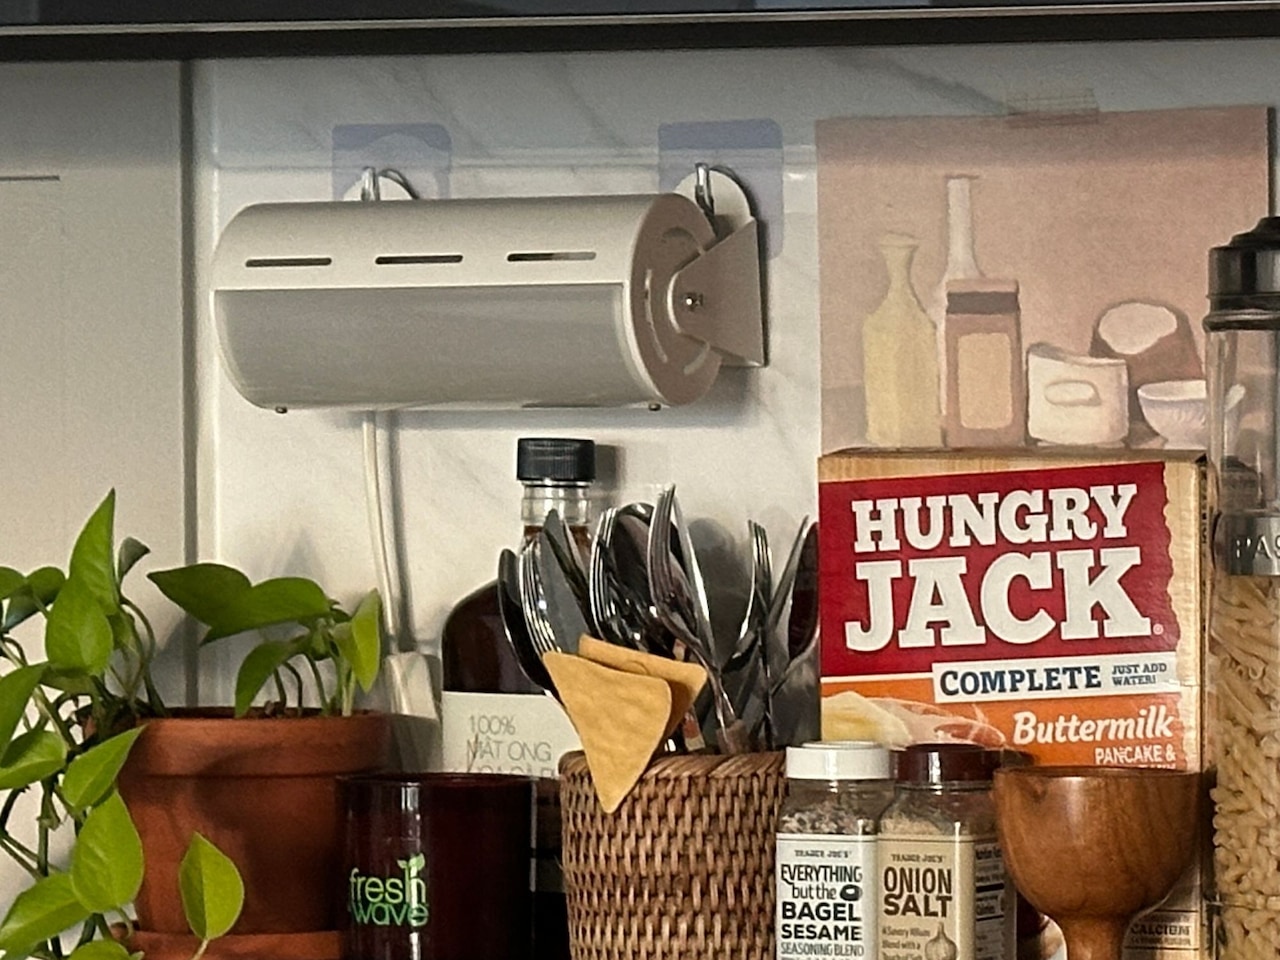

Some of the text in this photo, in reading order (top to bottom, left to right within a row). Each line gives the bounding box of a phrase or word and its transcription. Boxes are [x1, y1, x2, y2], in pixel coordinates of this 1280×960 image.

[852, 484, 1138, 553] HUNGRY
[845, 547, 1152, 652] JACK
[940, 662, 1168, 696] COMPLETE JUST ADD
[1112, 675, 1157, 687] WATER!
[470, 714, 516, 736] 100%
[1012, 705, 1174, 745] Buttermilk
[508, 740, 552, 762] ONG
[1094, 743, 1177, 765] PANCAKE &
[350, 862, 427, 904] fresh
[781, 863, 863, 884] EVERYTHING
[883, 866, 952, 895] ONION
[792, 882, 837, 900] but the
[350, 902, 430, 927] wave
[781, 901, 862, 922] BAGEL
[883, 893, 953, 918] SALT
[781, 923, 862, 942] SESAME
[781, 942, 865, 957] SEASONING BLEND
